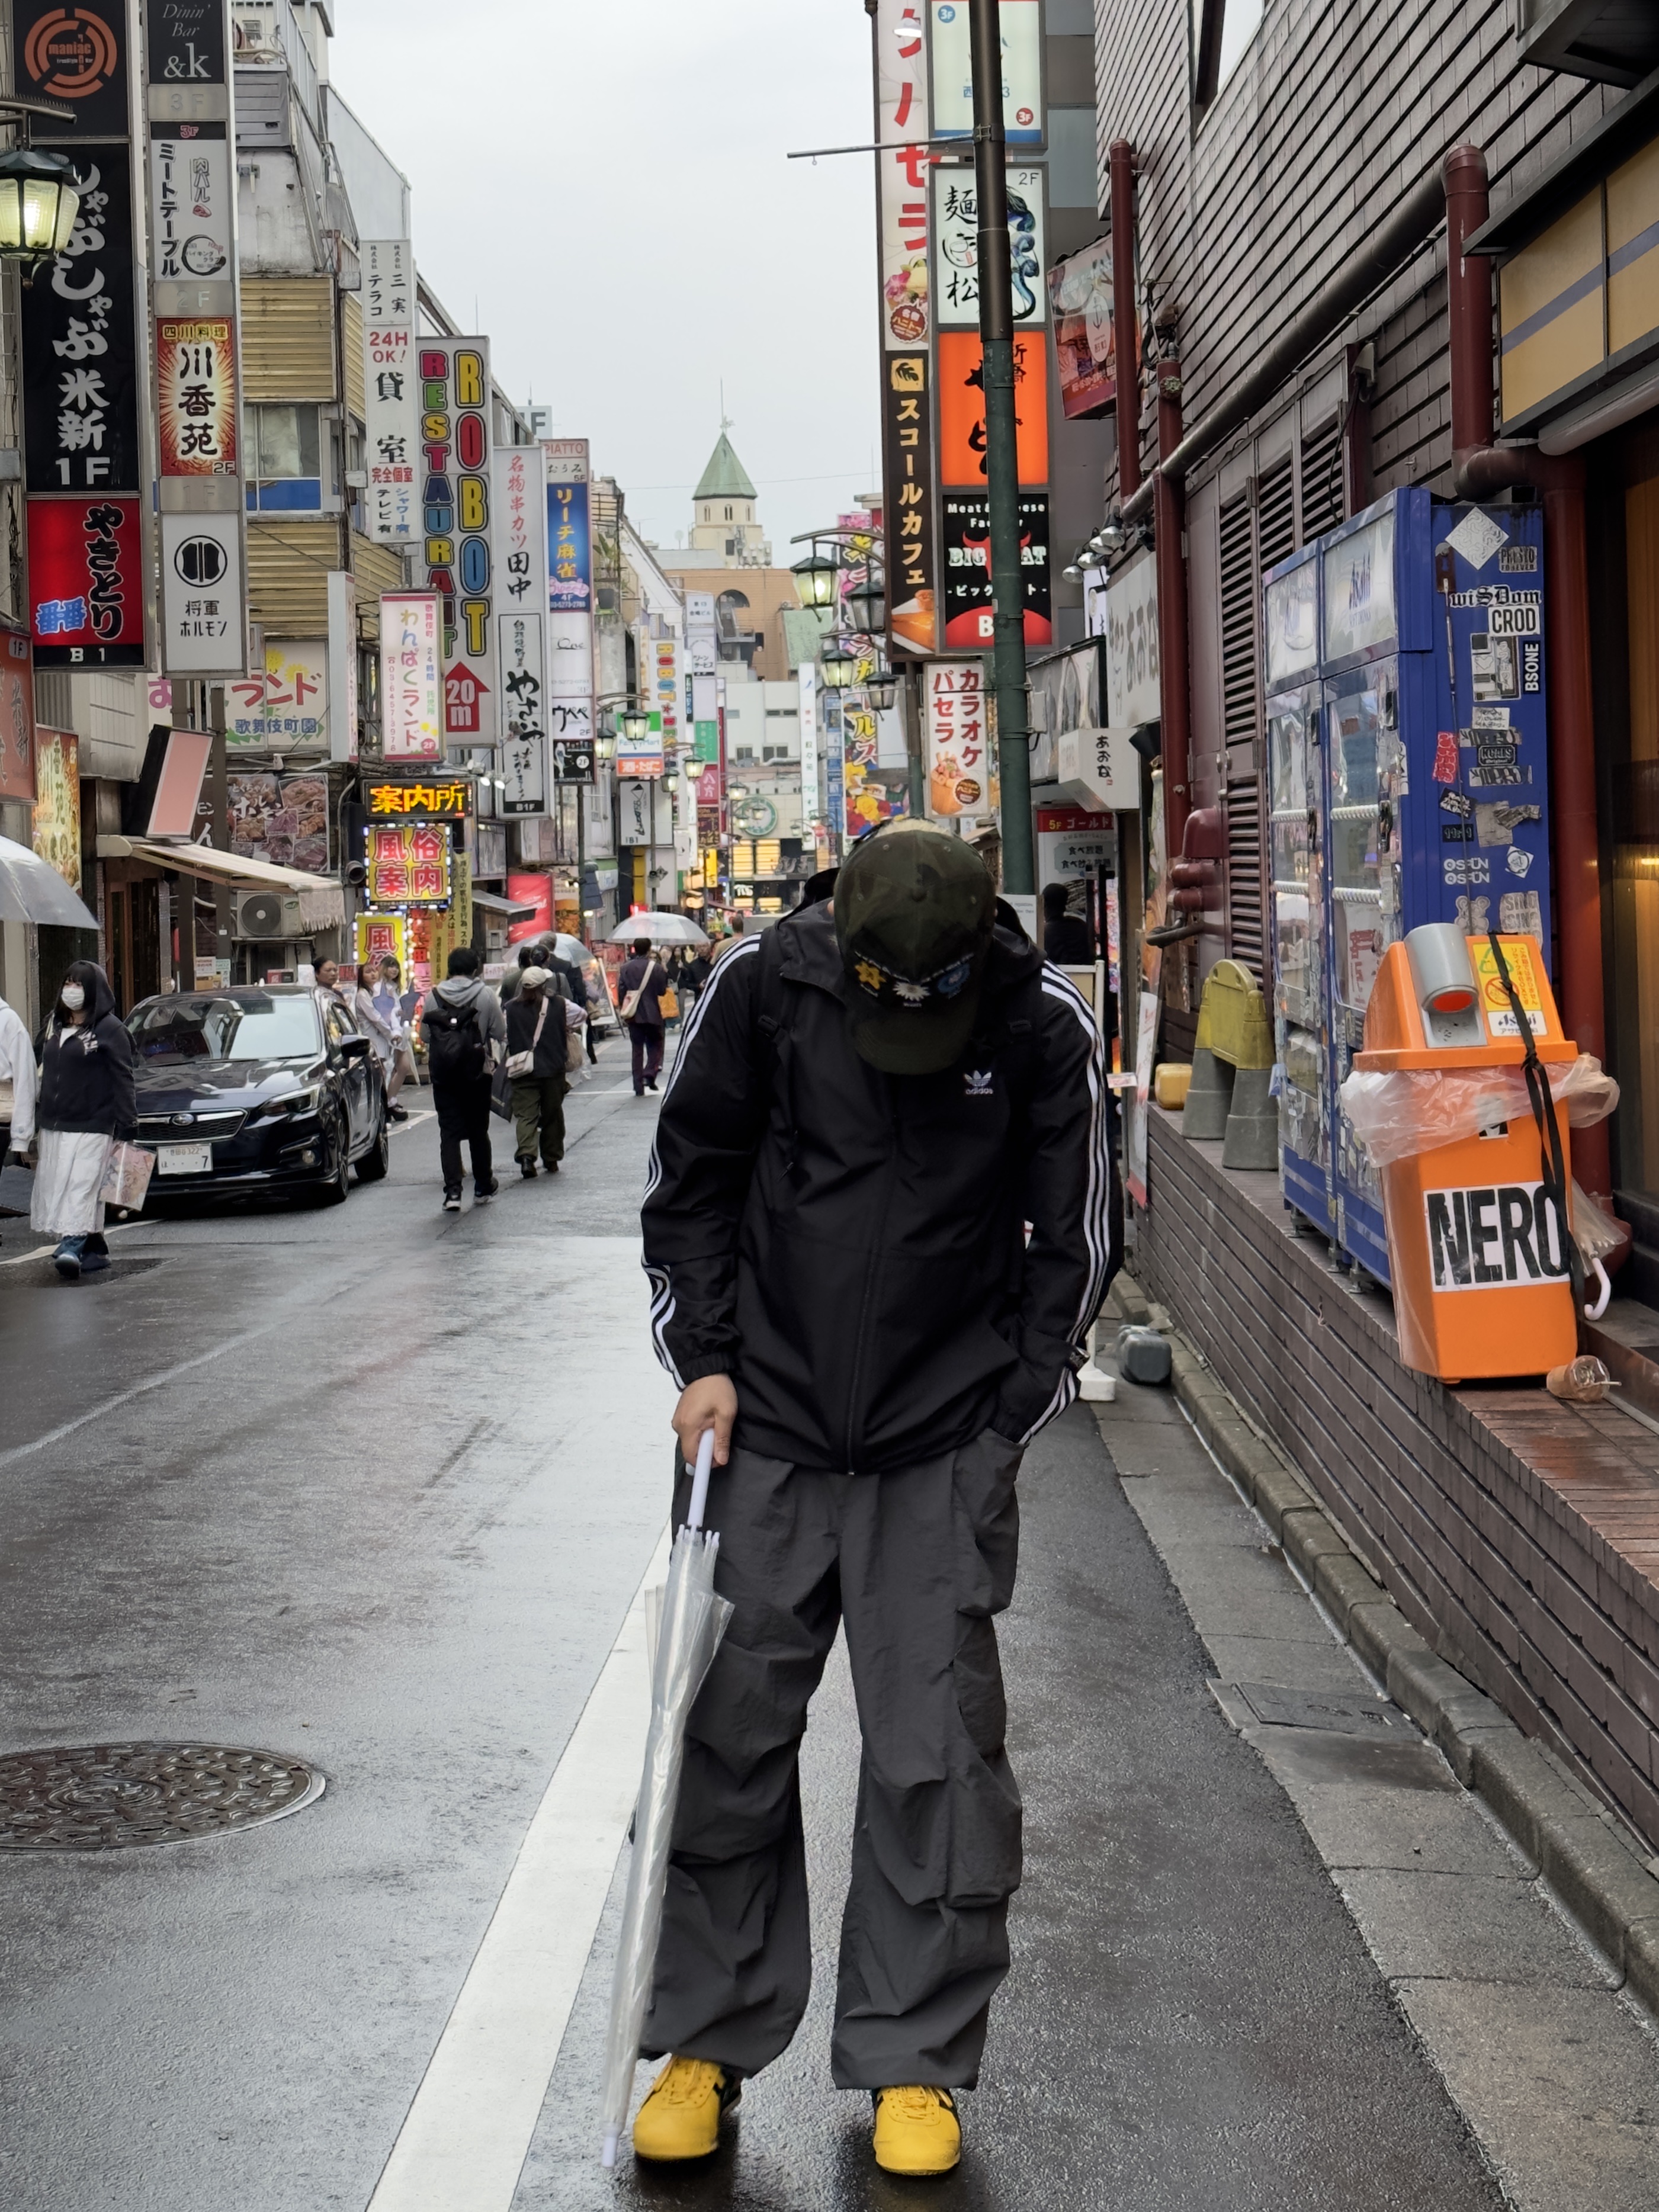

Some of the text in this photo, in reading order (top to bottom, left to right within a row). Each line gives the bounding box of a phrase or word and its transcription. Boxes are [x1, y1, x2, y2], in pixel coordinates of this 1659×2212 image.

[172, 23, 200, 37] Bar
[163, 43, 211, 78] &k
[1019, 172, 1039, 185] 2F
[159, 143, 180, 277] ミートテーブル
[368, 274, 383, 316] テラコ
[162, 325, 229, 339] 四川料理
[370, 332, 407, 346] 24H
[373, 350, 406, 363] OK!
[178, 347, 218, 457] 川香苑
[213, 462, 235, 474] 2F
[372, 467, 413, 483] 完全個室
[454, 349, 491, 657] ROBOT
[896, 399, 926, 585] スコールカフェ
[948, 503, 983, 513] Meat
[557, 488, 577, 579] リーチ麻雀
[948, 547, 987, 567] BIG
[84, 503, 124, 640] やきとり
[185, 601, 220, 616] 将軍
[1492, 608, 1536, 633] CROD
[180, 621, 227, 638] ホルモン
[400, 609, 419, 747] わんぱくランド
[1525, 643, 1539, 691] BSONE
[447, 679, 475, 705] 20
[451, 705, 471, 726] m
[933, 670, 955, 743] パセラ
[960, 670, 982, 766] カラオケ
[235, 717, 317, 735] 歌舞伎町園
[422, 741, 434, 750] 2F
[1095, 735, 1112, 778] あおな
[232, 795, 288, 821] ホルモン
[370, 785, 465, 813] 案内所
[374, 829, 443, 862] 風俗
[376, 864, 444, 897] 案内
[965, 1086, 994, 1094] adidas
[201, 1155, 208, 1168] 7
[1427, 1186, 1571, 1287] NERO
